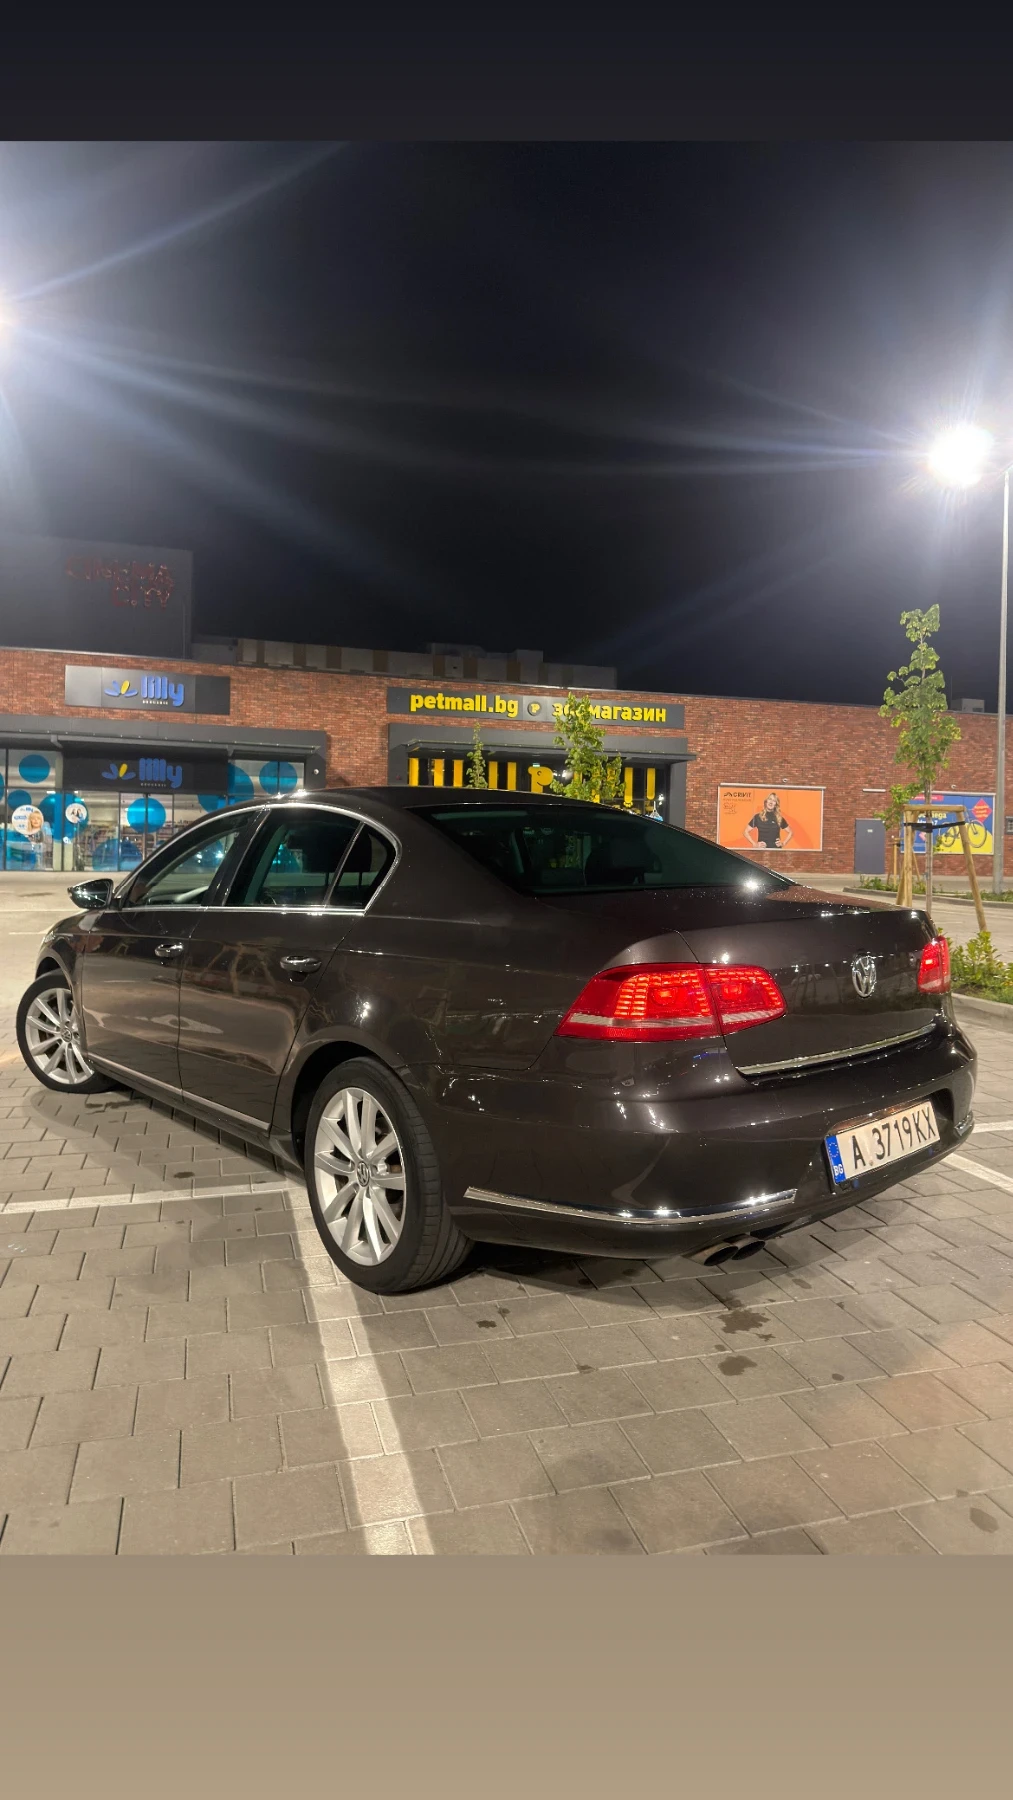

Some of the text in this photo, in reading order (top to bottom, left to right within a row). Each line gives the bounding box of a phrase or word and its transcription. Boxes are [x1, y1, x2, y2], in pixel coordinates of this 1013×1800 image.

[141, 675, 185, 706] lilly
[410, 692, 519, 718] petmall.bg
[139, 758, 182, 788] lilly
[833, 1163, 844, 1176] BG
